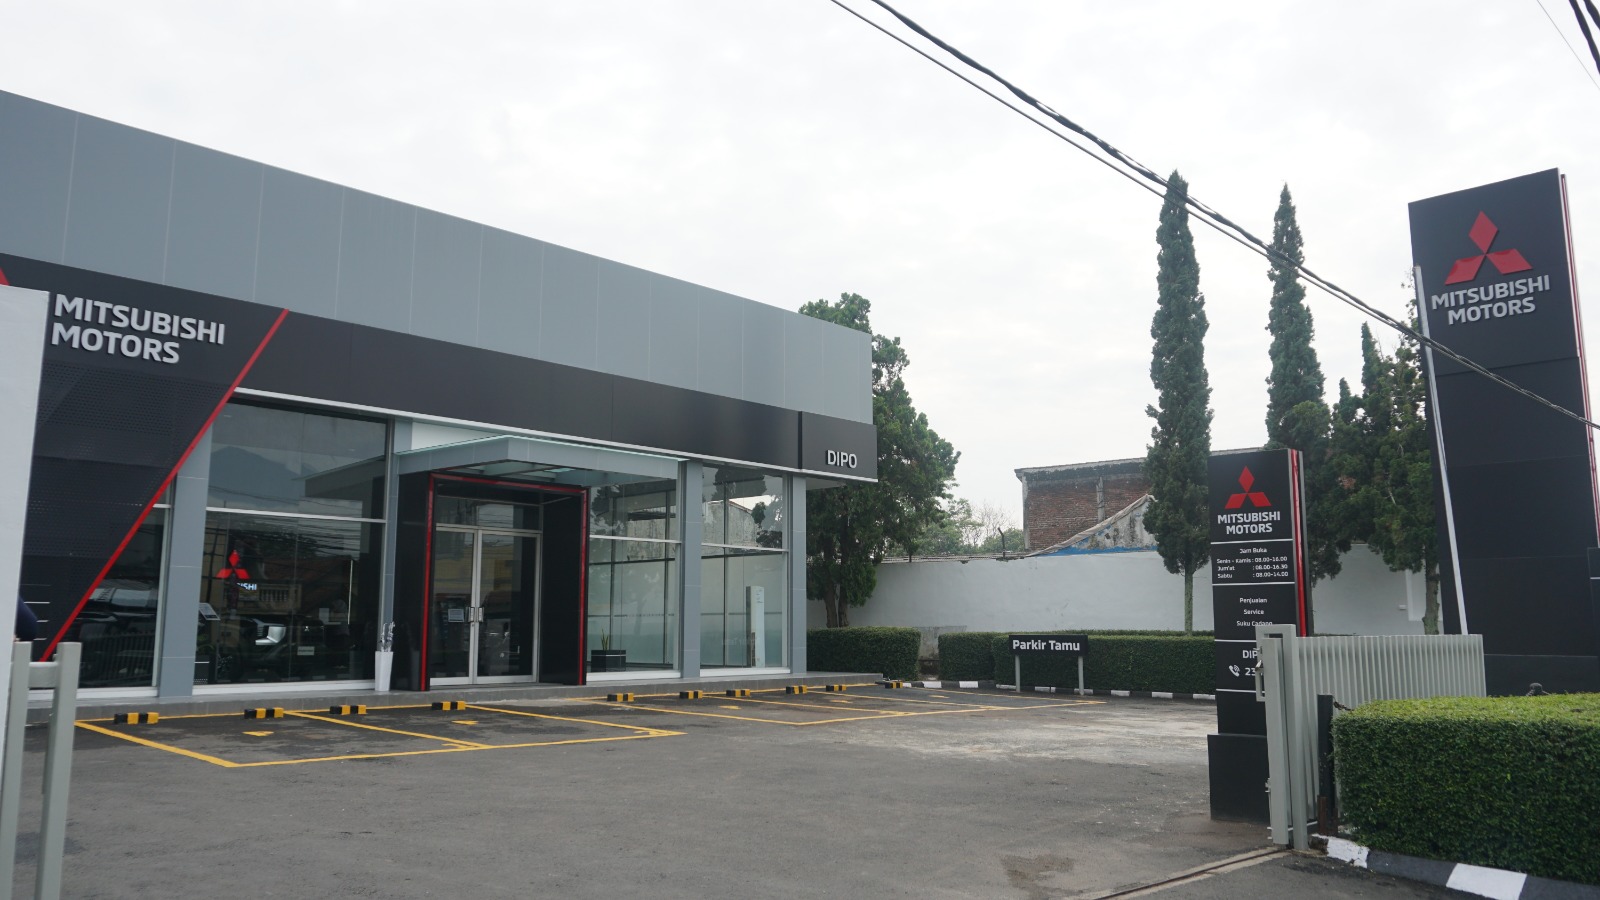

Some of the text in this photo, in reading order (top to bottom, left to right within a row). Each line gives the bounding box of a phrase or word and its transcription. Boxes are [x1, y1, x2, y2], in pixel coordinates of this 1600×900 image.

[1431, 274, 1550, 310] MITSUBISHI
[54, 293, 226, 345] MITSUBISHI
[1448, 297, 1536, 325] MOTORS
[51, 322, 180, 364] MOTORS
[827, 450, 857, 468] DIPO
[1217, 511, 1281, 524] MITSUBISHI
[1226, 523, 1273, 535] MOTORS
[1012, 639, 1080, 651] Parkir Tamu
[1242, 649, 1259, 659] DIP
